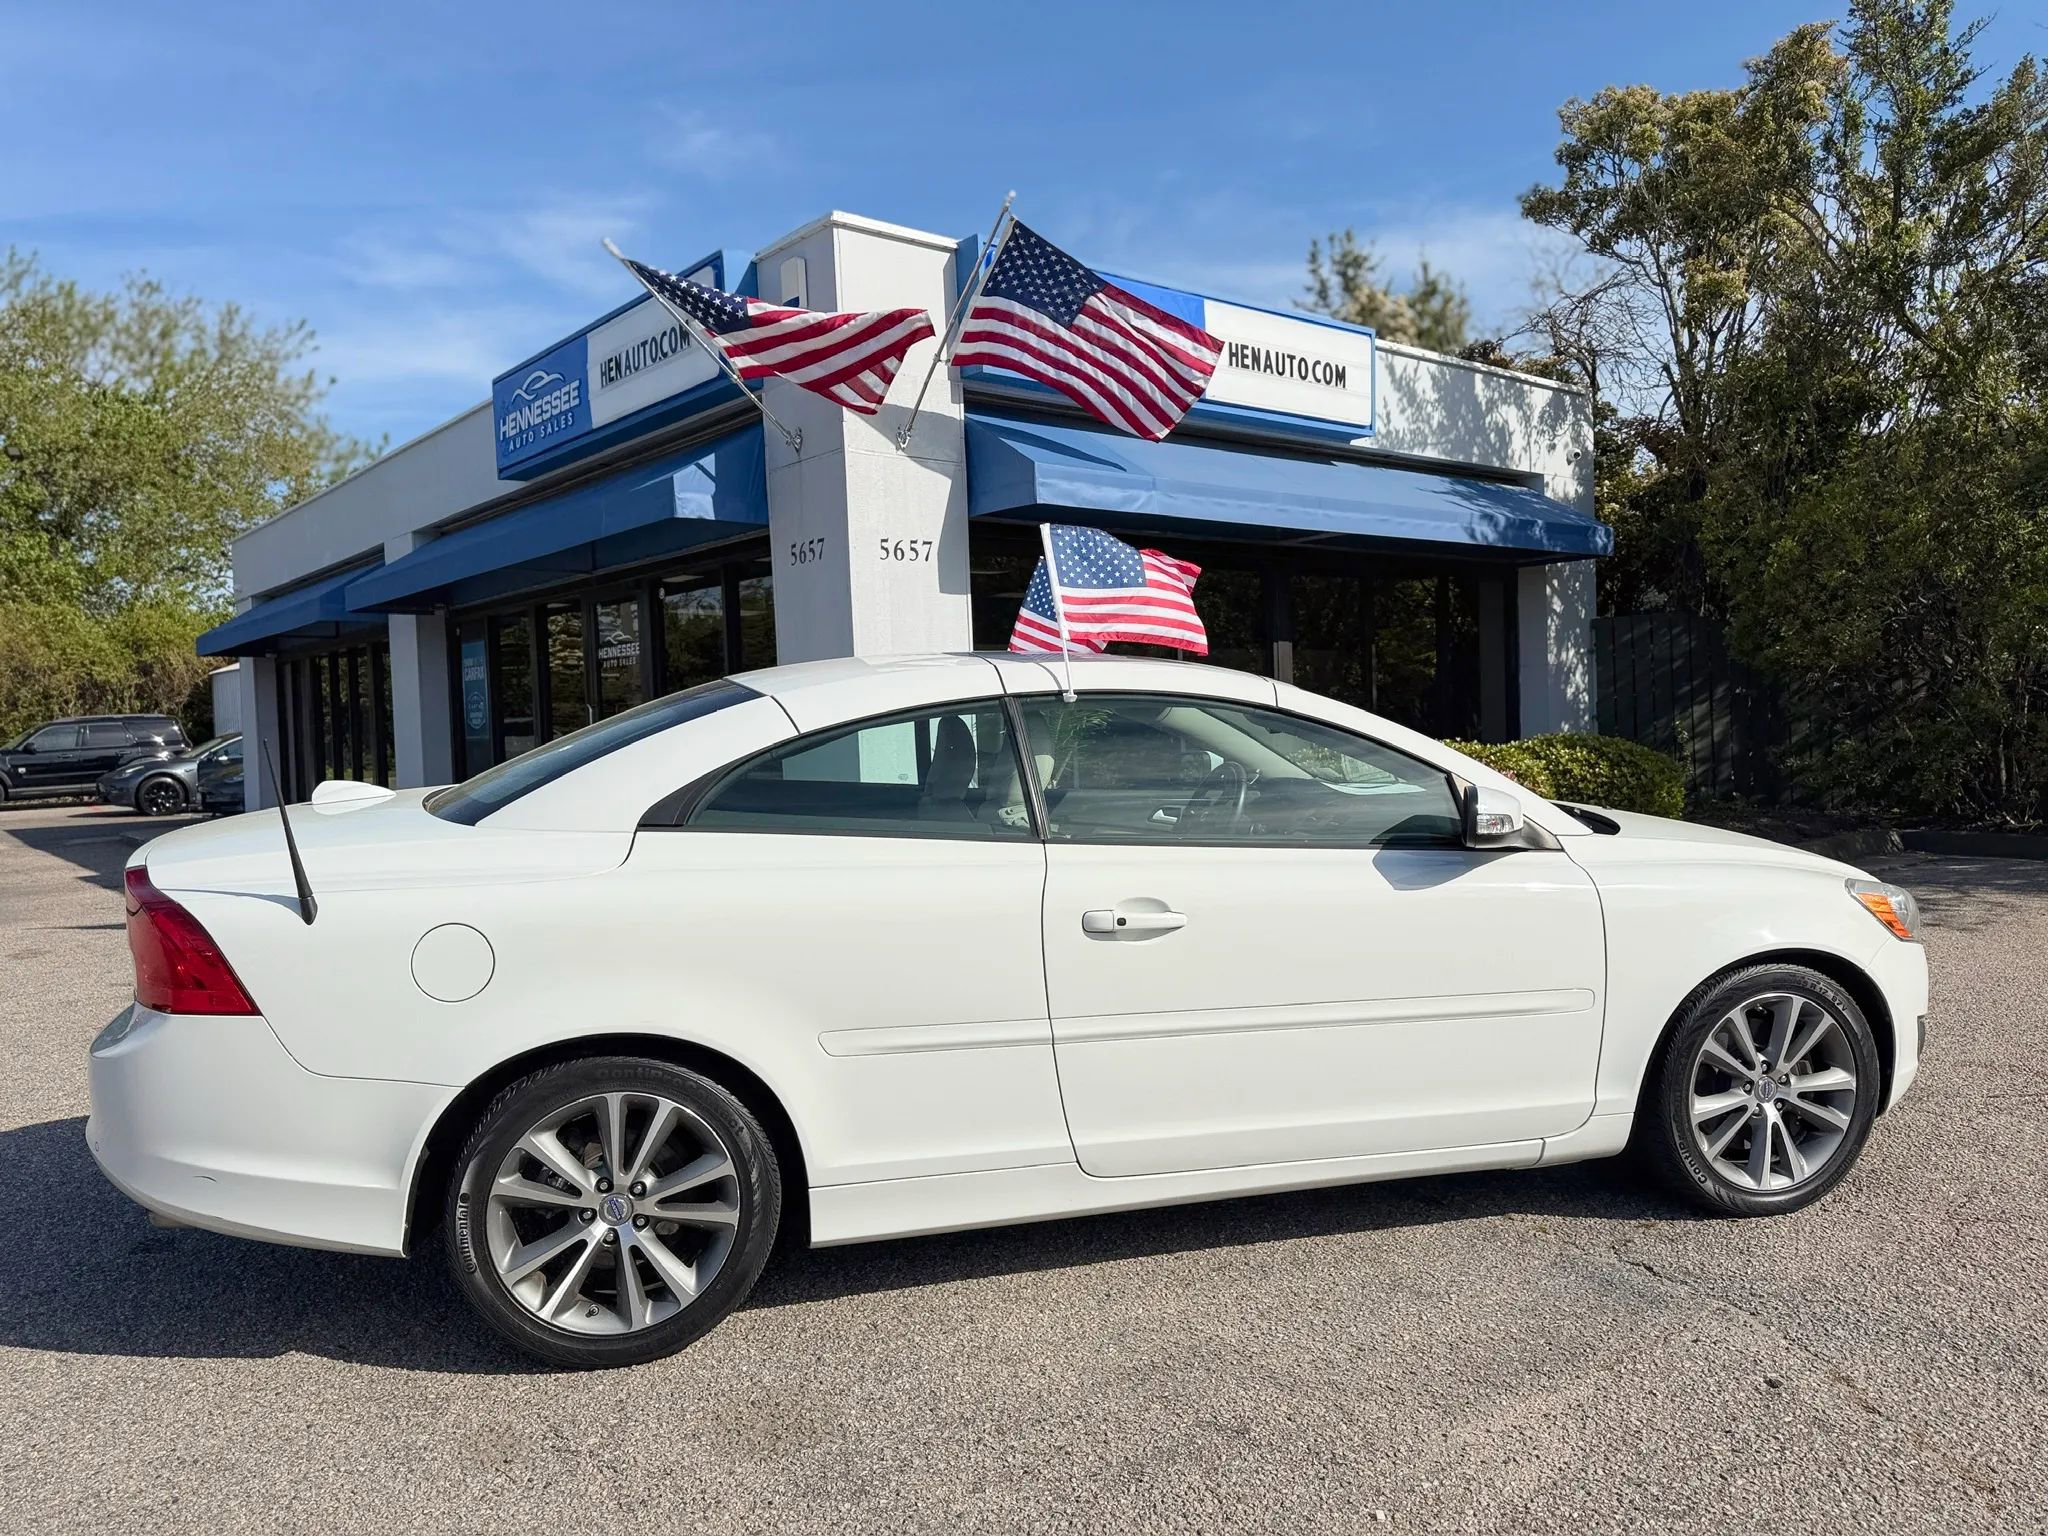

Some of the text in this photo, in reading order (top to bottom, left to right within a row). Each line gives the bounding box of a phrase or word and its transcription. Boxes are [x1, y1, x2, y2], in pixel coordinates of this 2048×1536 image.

[1228, 341, 1347, 389] HENAUTOCOM
[500, 379, 580, 441] HENNESSEE
[508, 411, 574, 452] AUTO SALES
[790, 537, 825, 566] 5657
[879, 537, 933, 562] 5657
[598, 642, 640, 659] HENNESSEE
